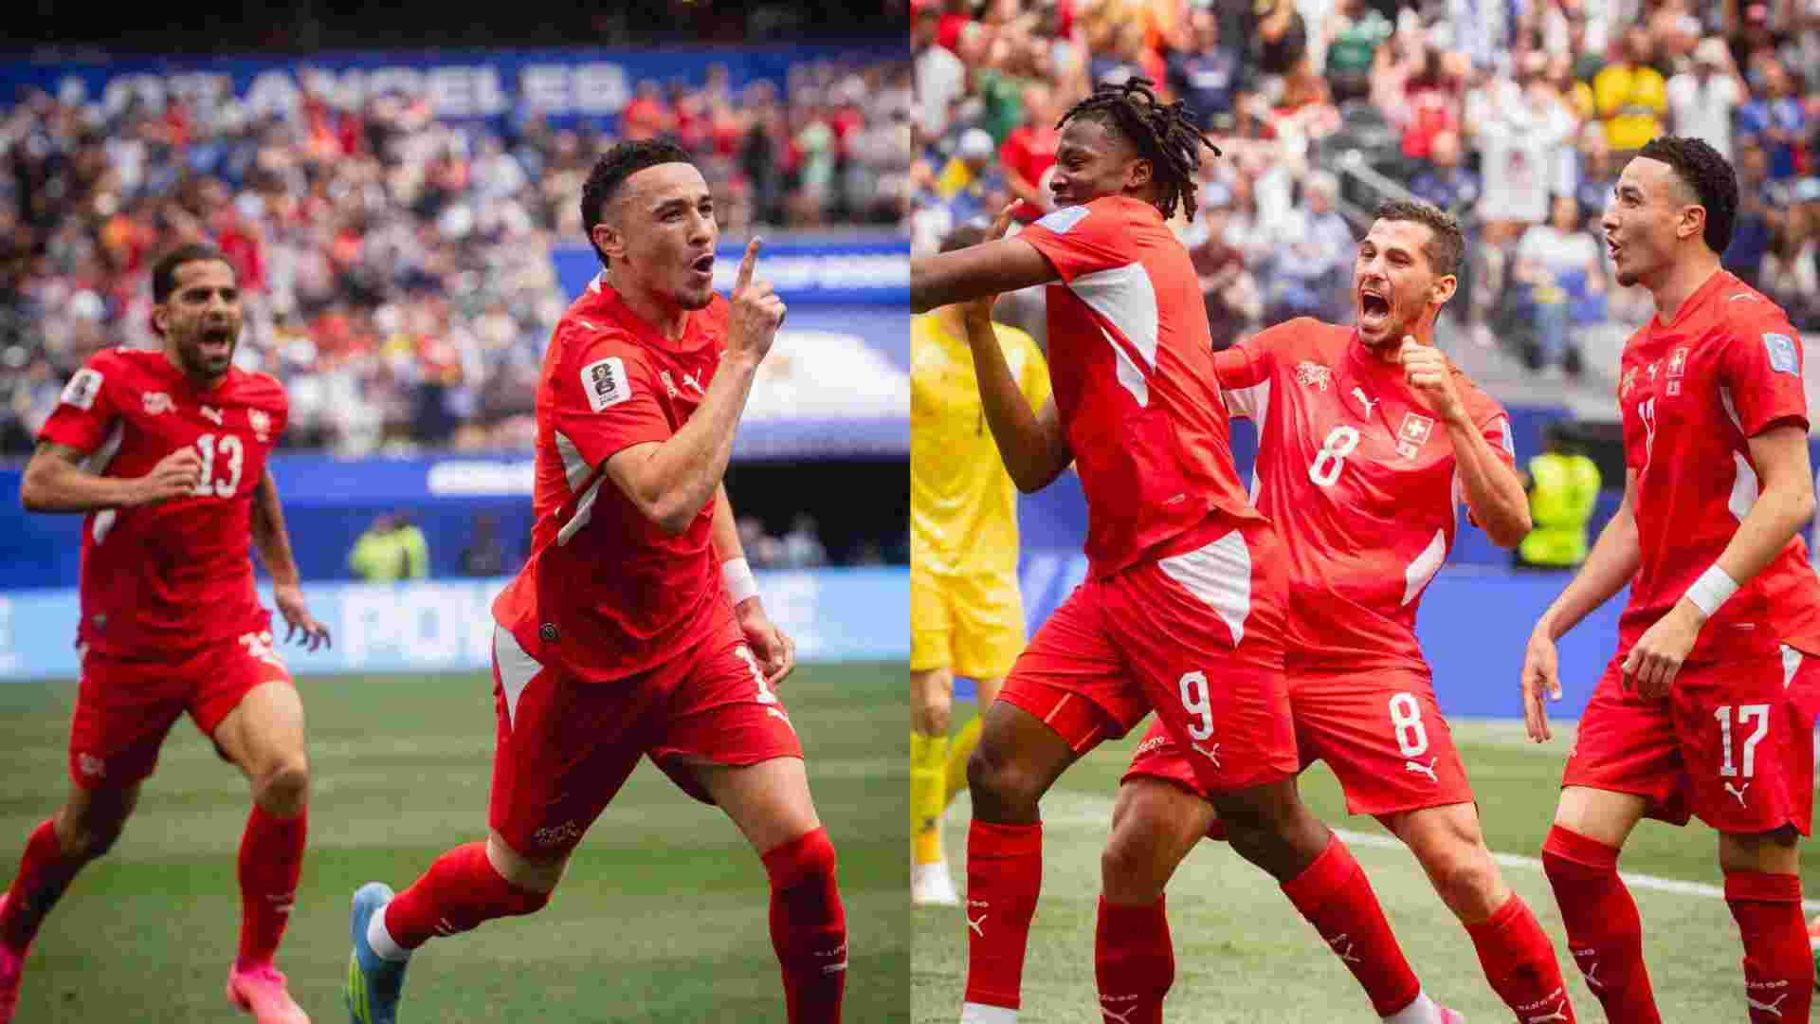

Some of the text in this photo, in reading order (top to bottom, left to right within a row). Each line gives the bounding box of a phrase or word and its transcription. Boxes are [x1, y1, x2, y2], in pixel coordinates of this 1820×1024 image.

[192, 433, 244, 498] 13
[1308, 425, 1360, 487] 8
[1178, 670, 1214, 740] 9
[1388, 692, 1428, 757] 8
[1713, 703, 1770, 778] 17
